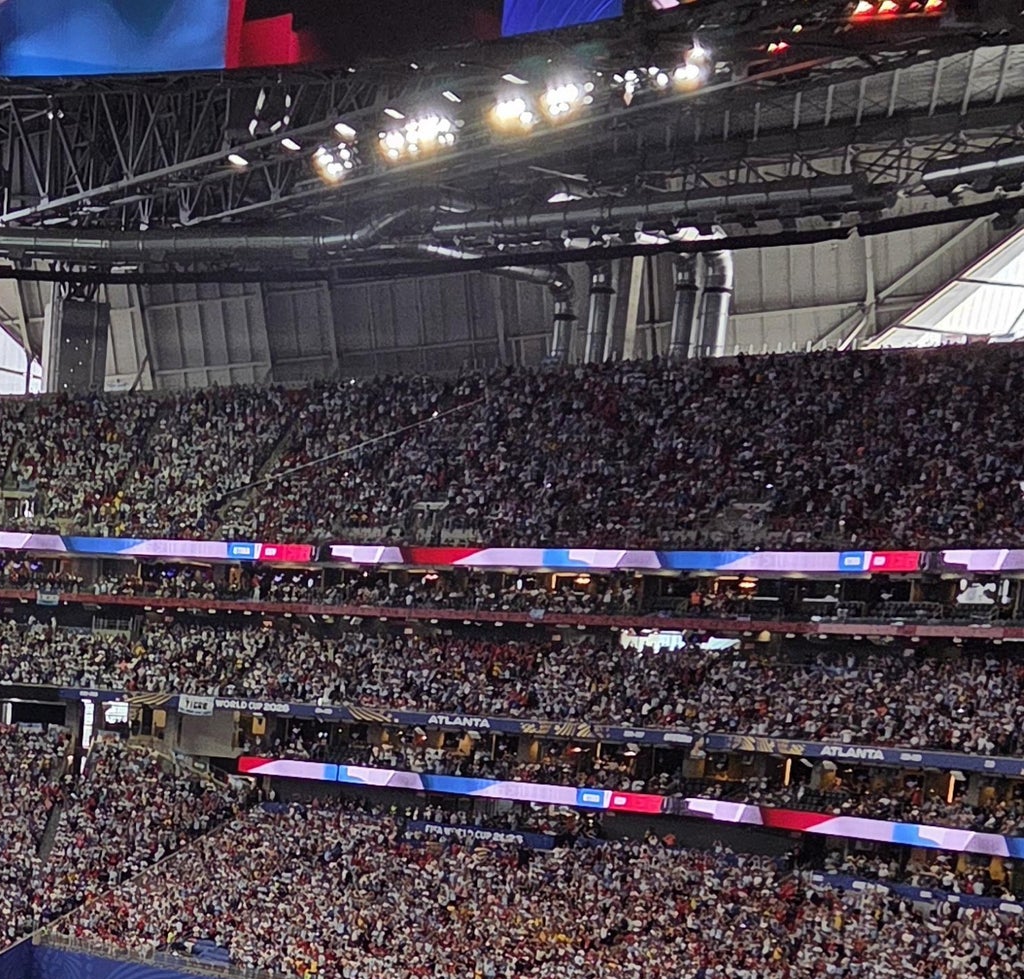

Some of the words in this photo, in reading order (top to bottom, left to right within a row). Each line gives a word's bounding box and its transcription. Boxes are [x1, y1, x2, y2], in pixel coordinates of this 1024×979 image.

[215, 699, 247, 709] WORLD
[263, 703, 290, 713] 2026
[427, 715, 490, 729] ATLANTA
[820, 746, 884, 760] ATLANTA
[475, 830, 492, 840] CUP
